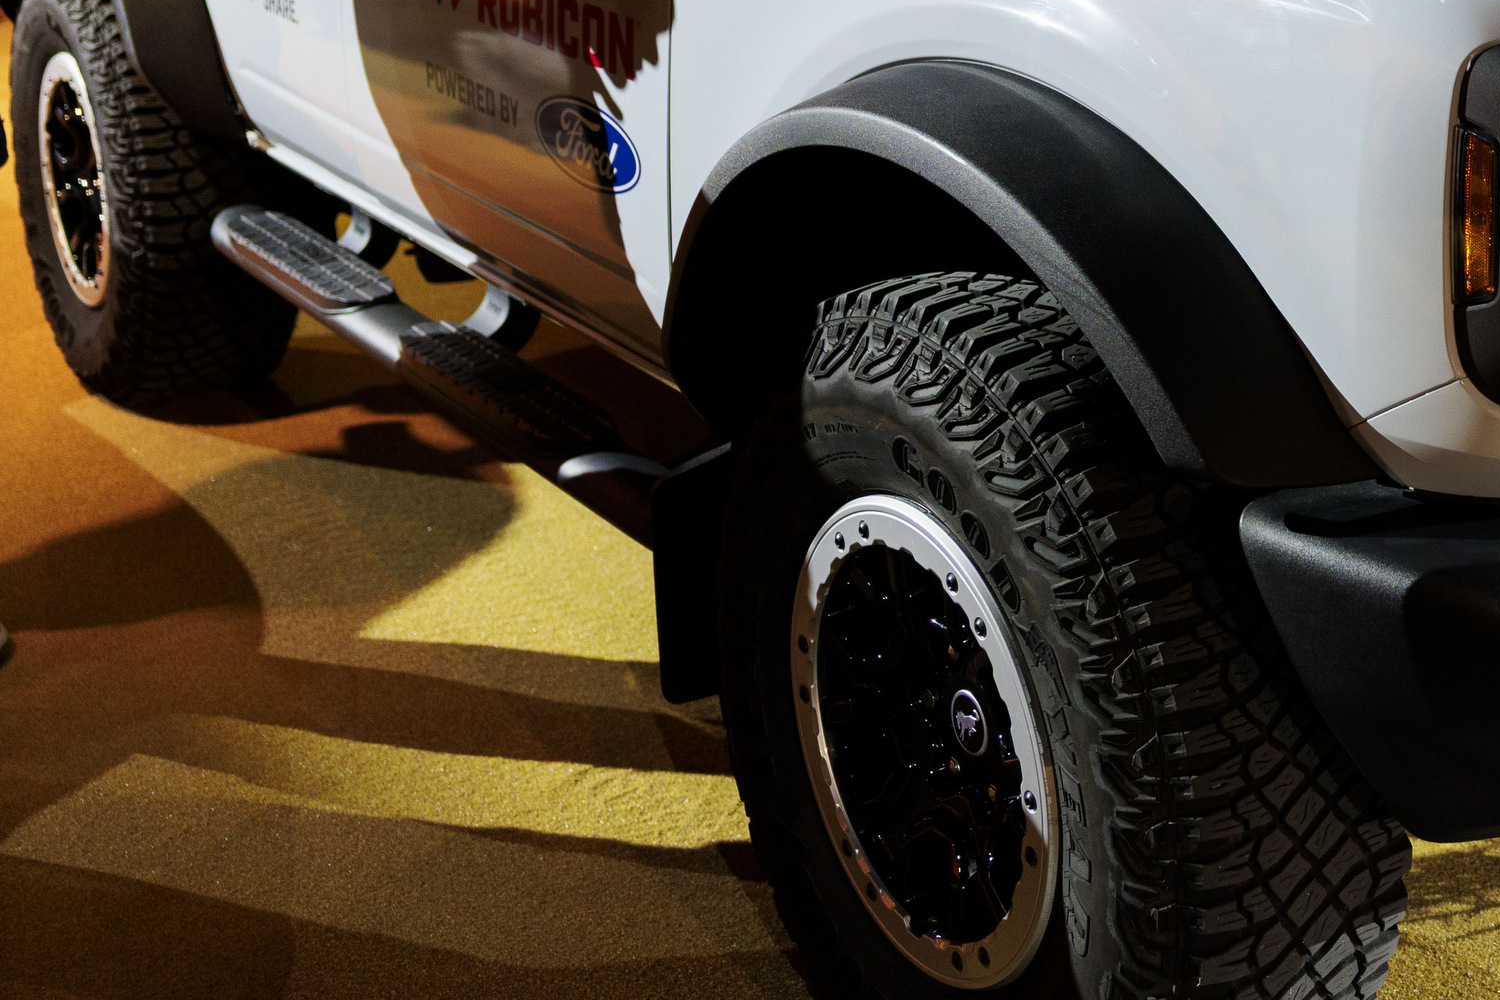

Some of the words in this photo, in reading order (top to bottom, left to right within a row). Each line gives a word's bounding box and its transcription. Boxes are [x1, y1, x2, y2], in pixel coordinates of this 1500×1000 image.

[425, 62, 496, 117] POWERED
[499, 94, 519, 128] BY
[555, 108, 618, 182] Ford
